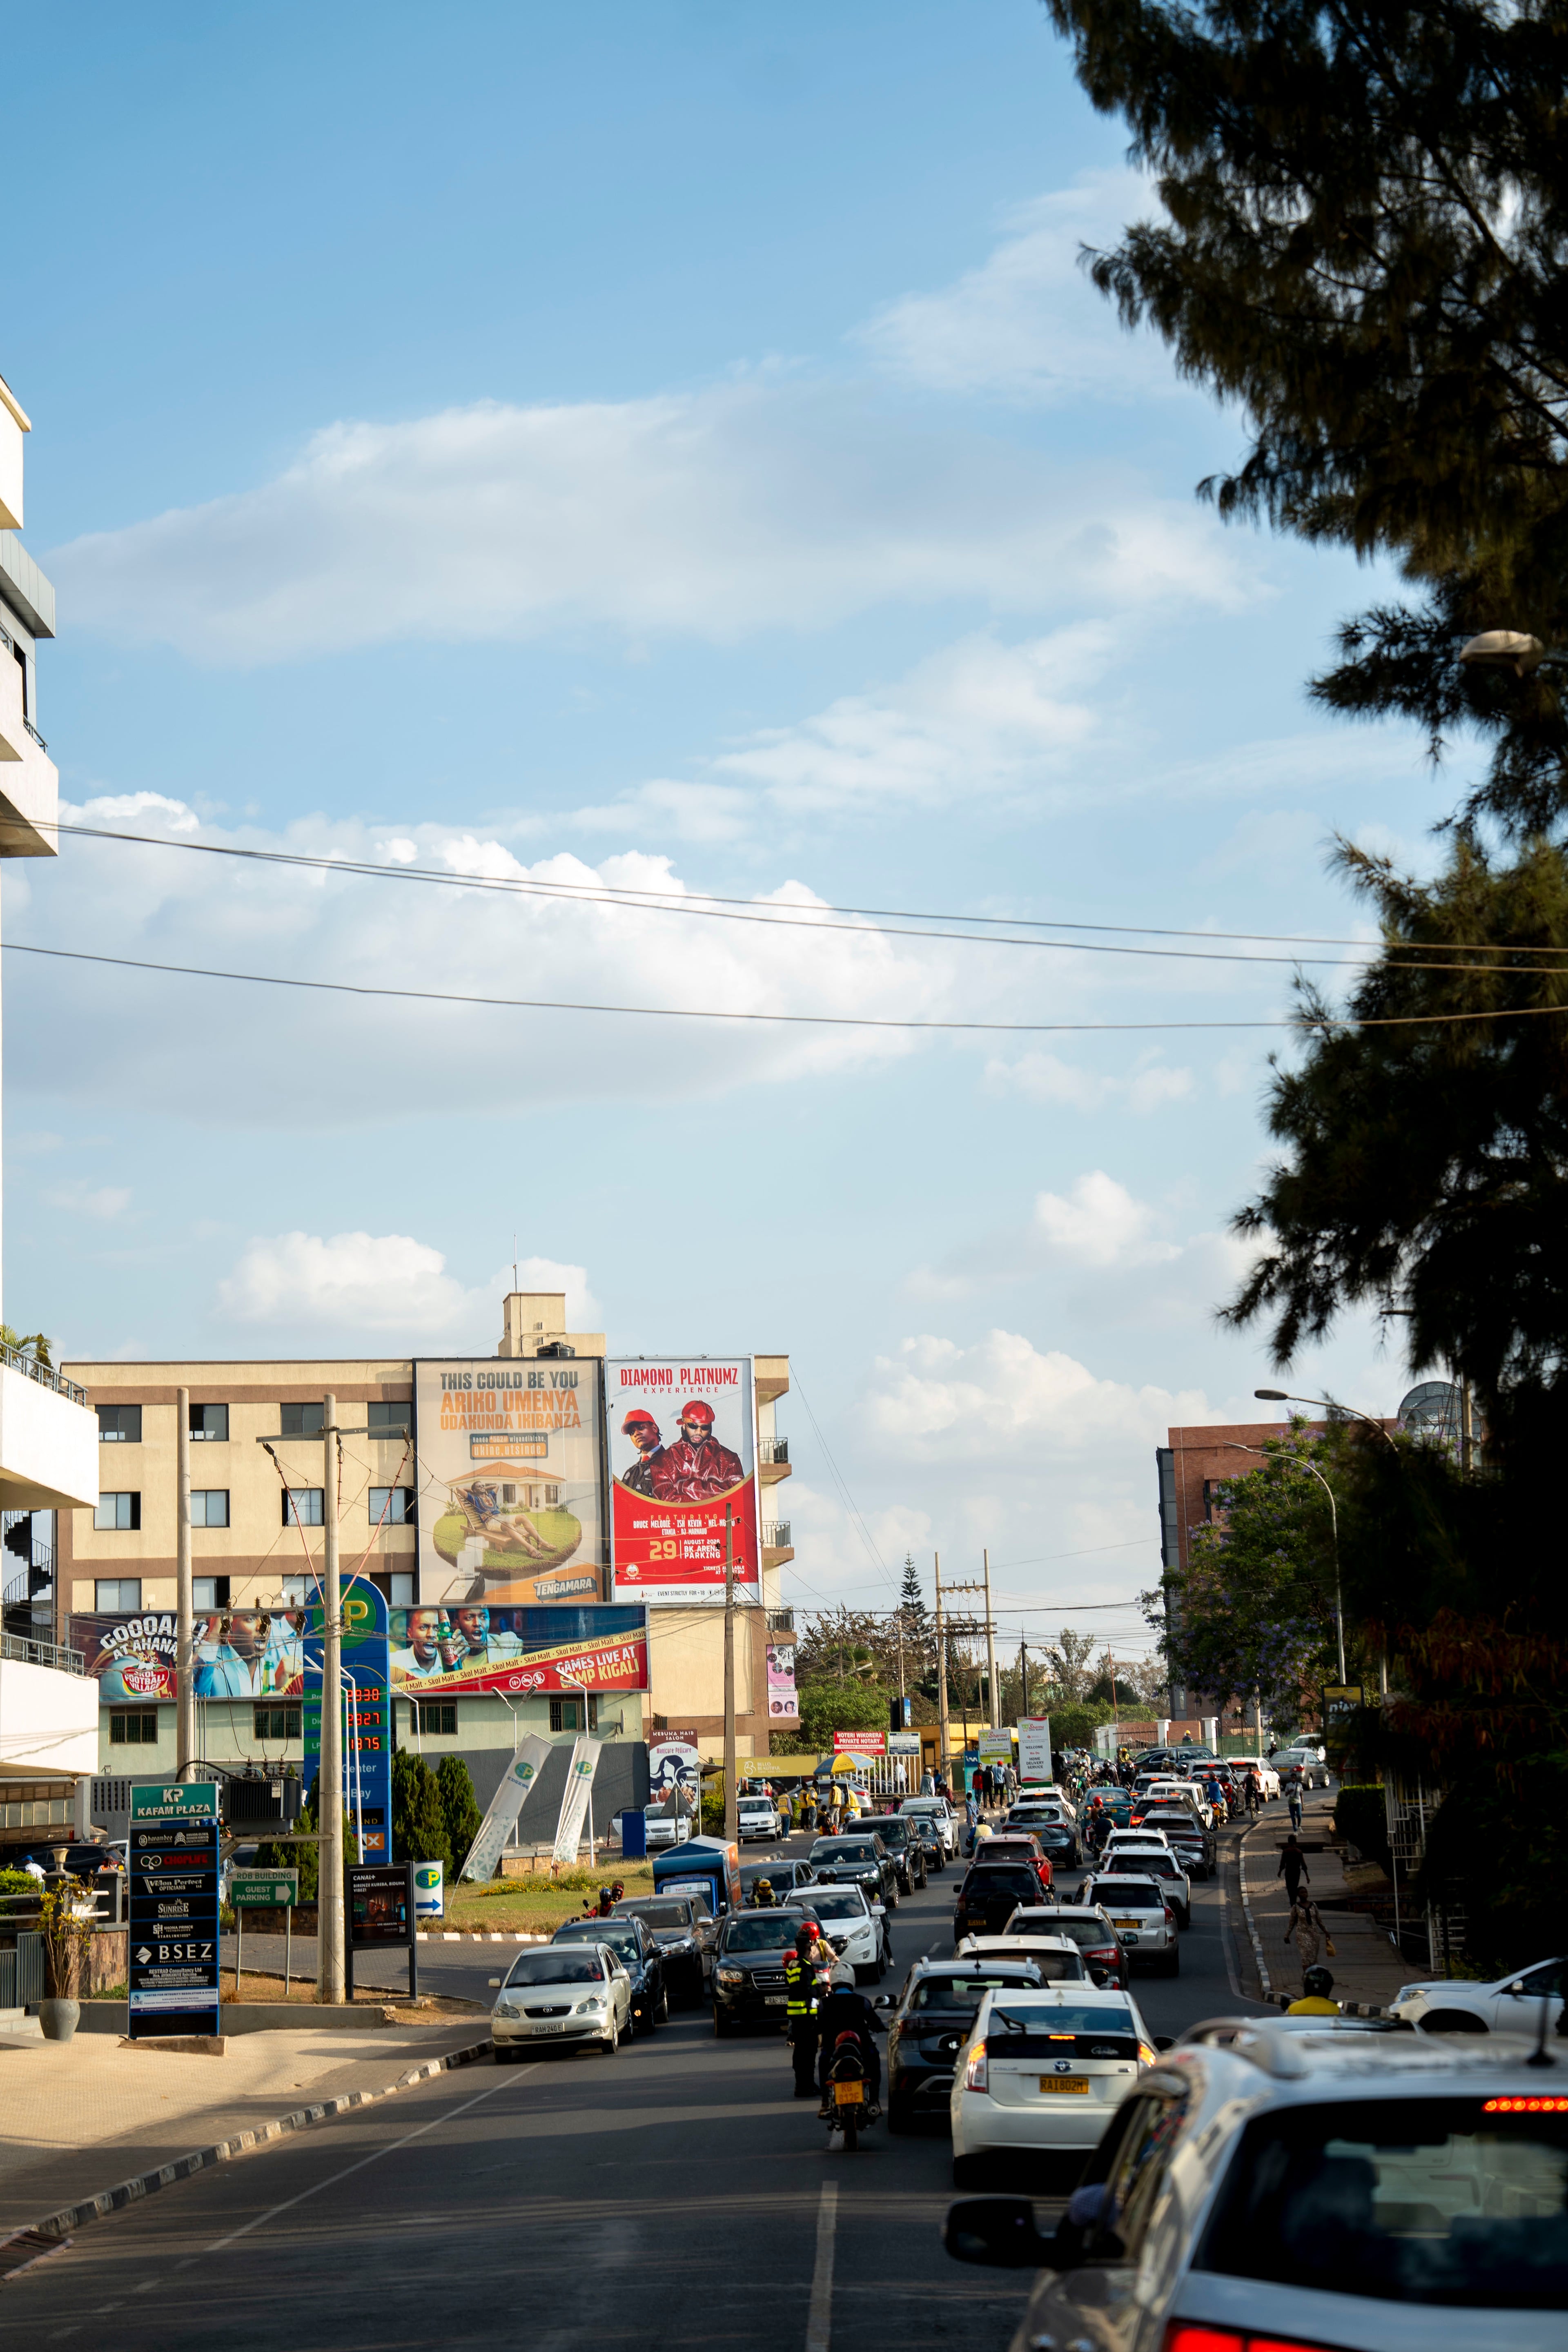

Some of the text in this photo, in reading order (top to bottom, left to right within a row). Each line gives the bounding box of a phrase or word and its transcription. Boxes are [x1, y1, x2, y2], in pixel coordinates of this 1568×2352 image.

[441, 1371, 578, 1390] THIS COULD BE YOU
[620, 1368, 738, 1385] DIAMOND PLATNUMZ
[441, 1390, 579, 1413] ARIKO UMENYA
[440, 1413, 581, 1430] UDAKUNDA IKIBANZA
[633, 1519, 718, 1528] BRUCE MELODIE ISH KEVIN NEL
[650, 1540, 677, 1559] 29
[534, 1577, 592, 1596] TENGAMARA
[113, 1643, 128, 1660] AT
[556, 1646, 636, 1673] GAMES LIVE AT
[410, 1681, 423, 1690] Malt
[428, 1677, 441, 1686] Skol
[441, 1674, 455, 1684] Malt
[460, 1670, 473, 1679] Skol
[474, 1667, 487, 1676] Malt
[492, 1663, 505, 1672] Skol
[506, 1659, 519, 1669] Malt
[524, 1655, 537, 1664] Skol
[538, 1652, 551, 1662] Malt
[556, 1648, 568, 1657] Skol
[569, 1644, 583, 1654] Malt
[588, 1640, 600, 1650] Skol
[601, 1637, 615, 1646] Malt
[619, 1633, 632, 1643] Skol
[598, 1658, 640, 1681] KIGALI
[125, 1674, 166, 1685] FOOTBALL
[129, 1681, 160, 1691] VILLAGE
[163, 1788, 183, 1803] KP
[351, 1788, 371, 1800] Bay
[137, 1803, 211, 1817] KAFAM PLAZA
[164, 1854, 207, 1865] CHOPLIFE
[419, 1871, 440, 1886] SP
[159, 1943, 212, 1960] BSEZ
[841, 2082, 853, 2093] RG
